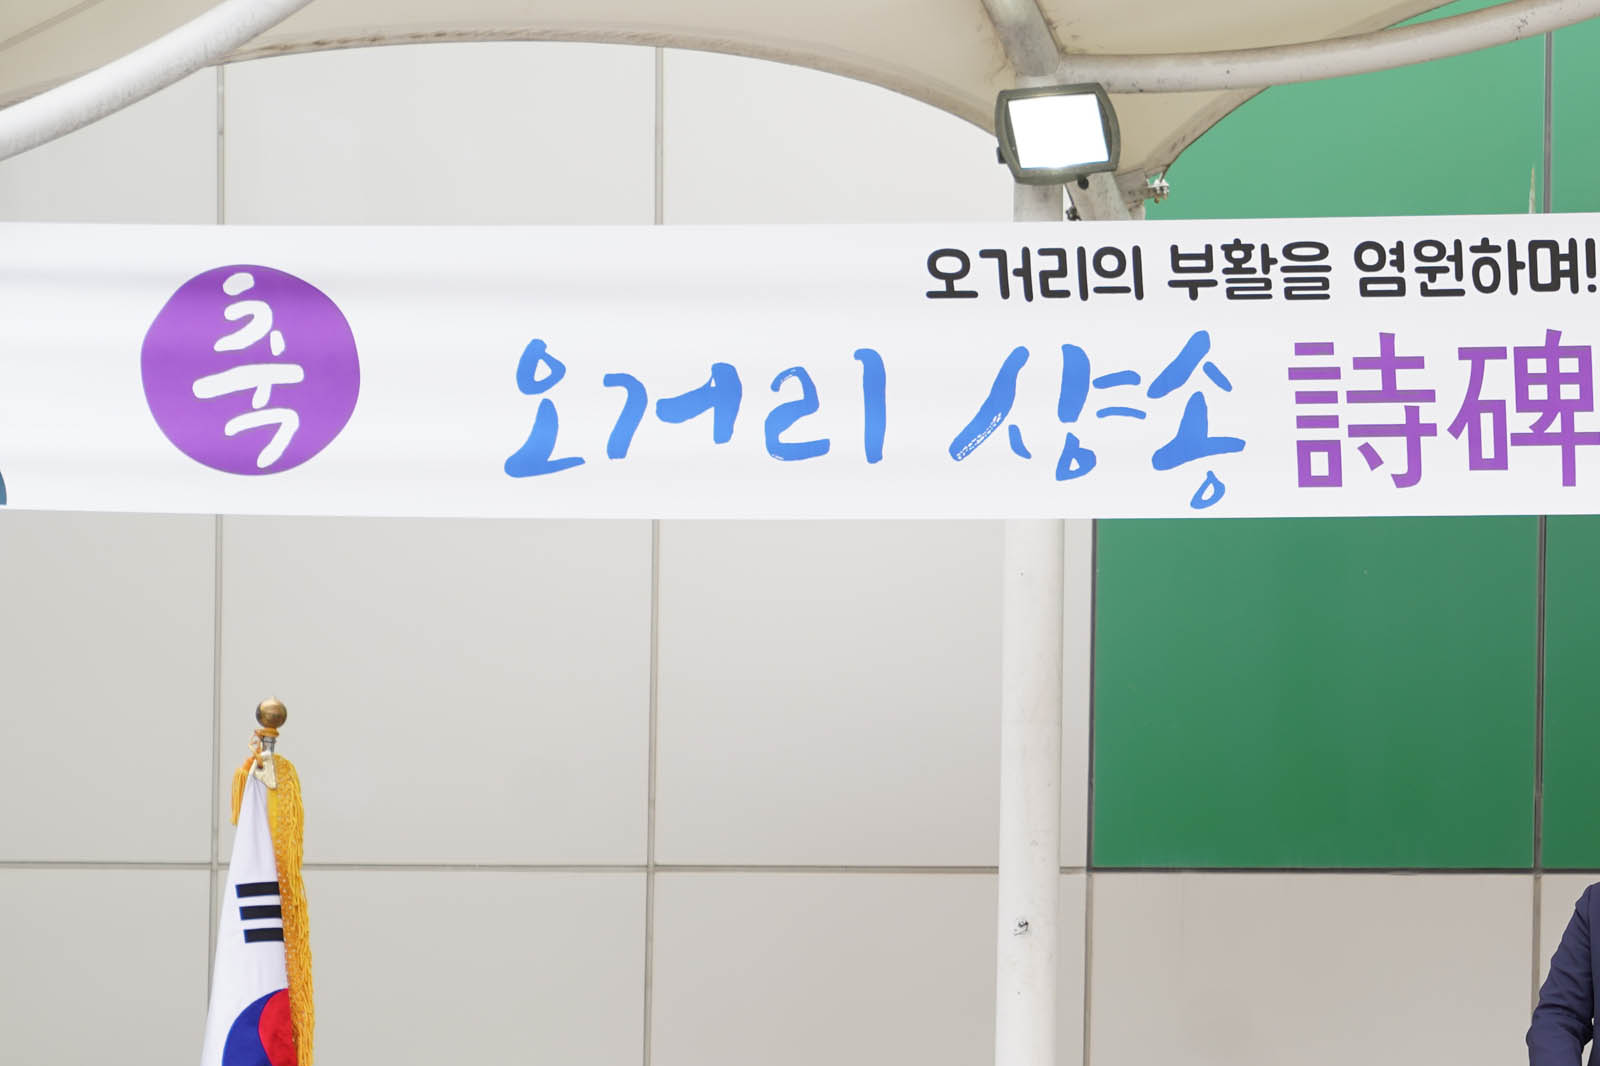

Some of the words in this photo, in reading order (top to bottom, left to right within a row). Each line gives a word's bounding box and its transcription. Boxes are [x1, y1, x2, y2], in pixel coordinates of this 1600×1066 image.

[926, 245, 1144, 302] 오거리의
[1167, 238, 1332, 301] 부활을
[1353, 237, 1597, 298] 염원하며!
[192, 271, 305, 468] 축
[504, 338, 887, 478] 오거리
[948, 330, 1247, 510] 샹송
